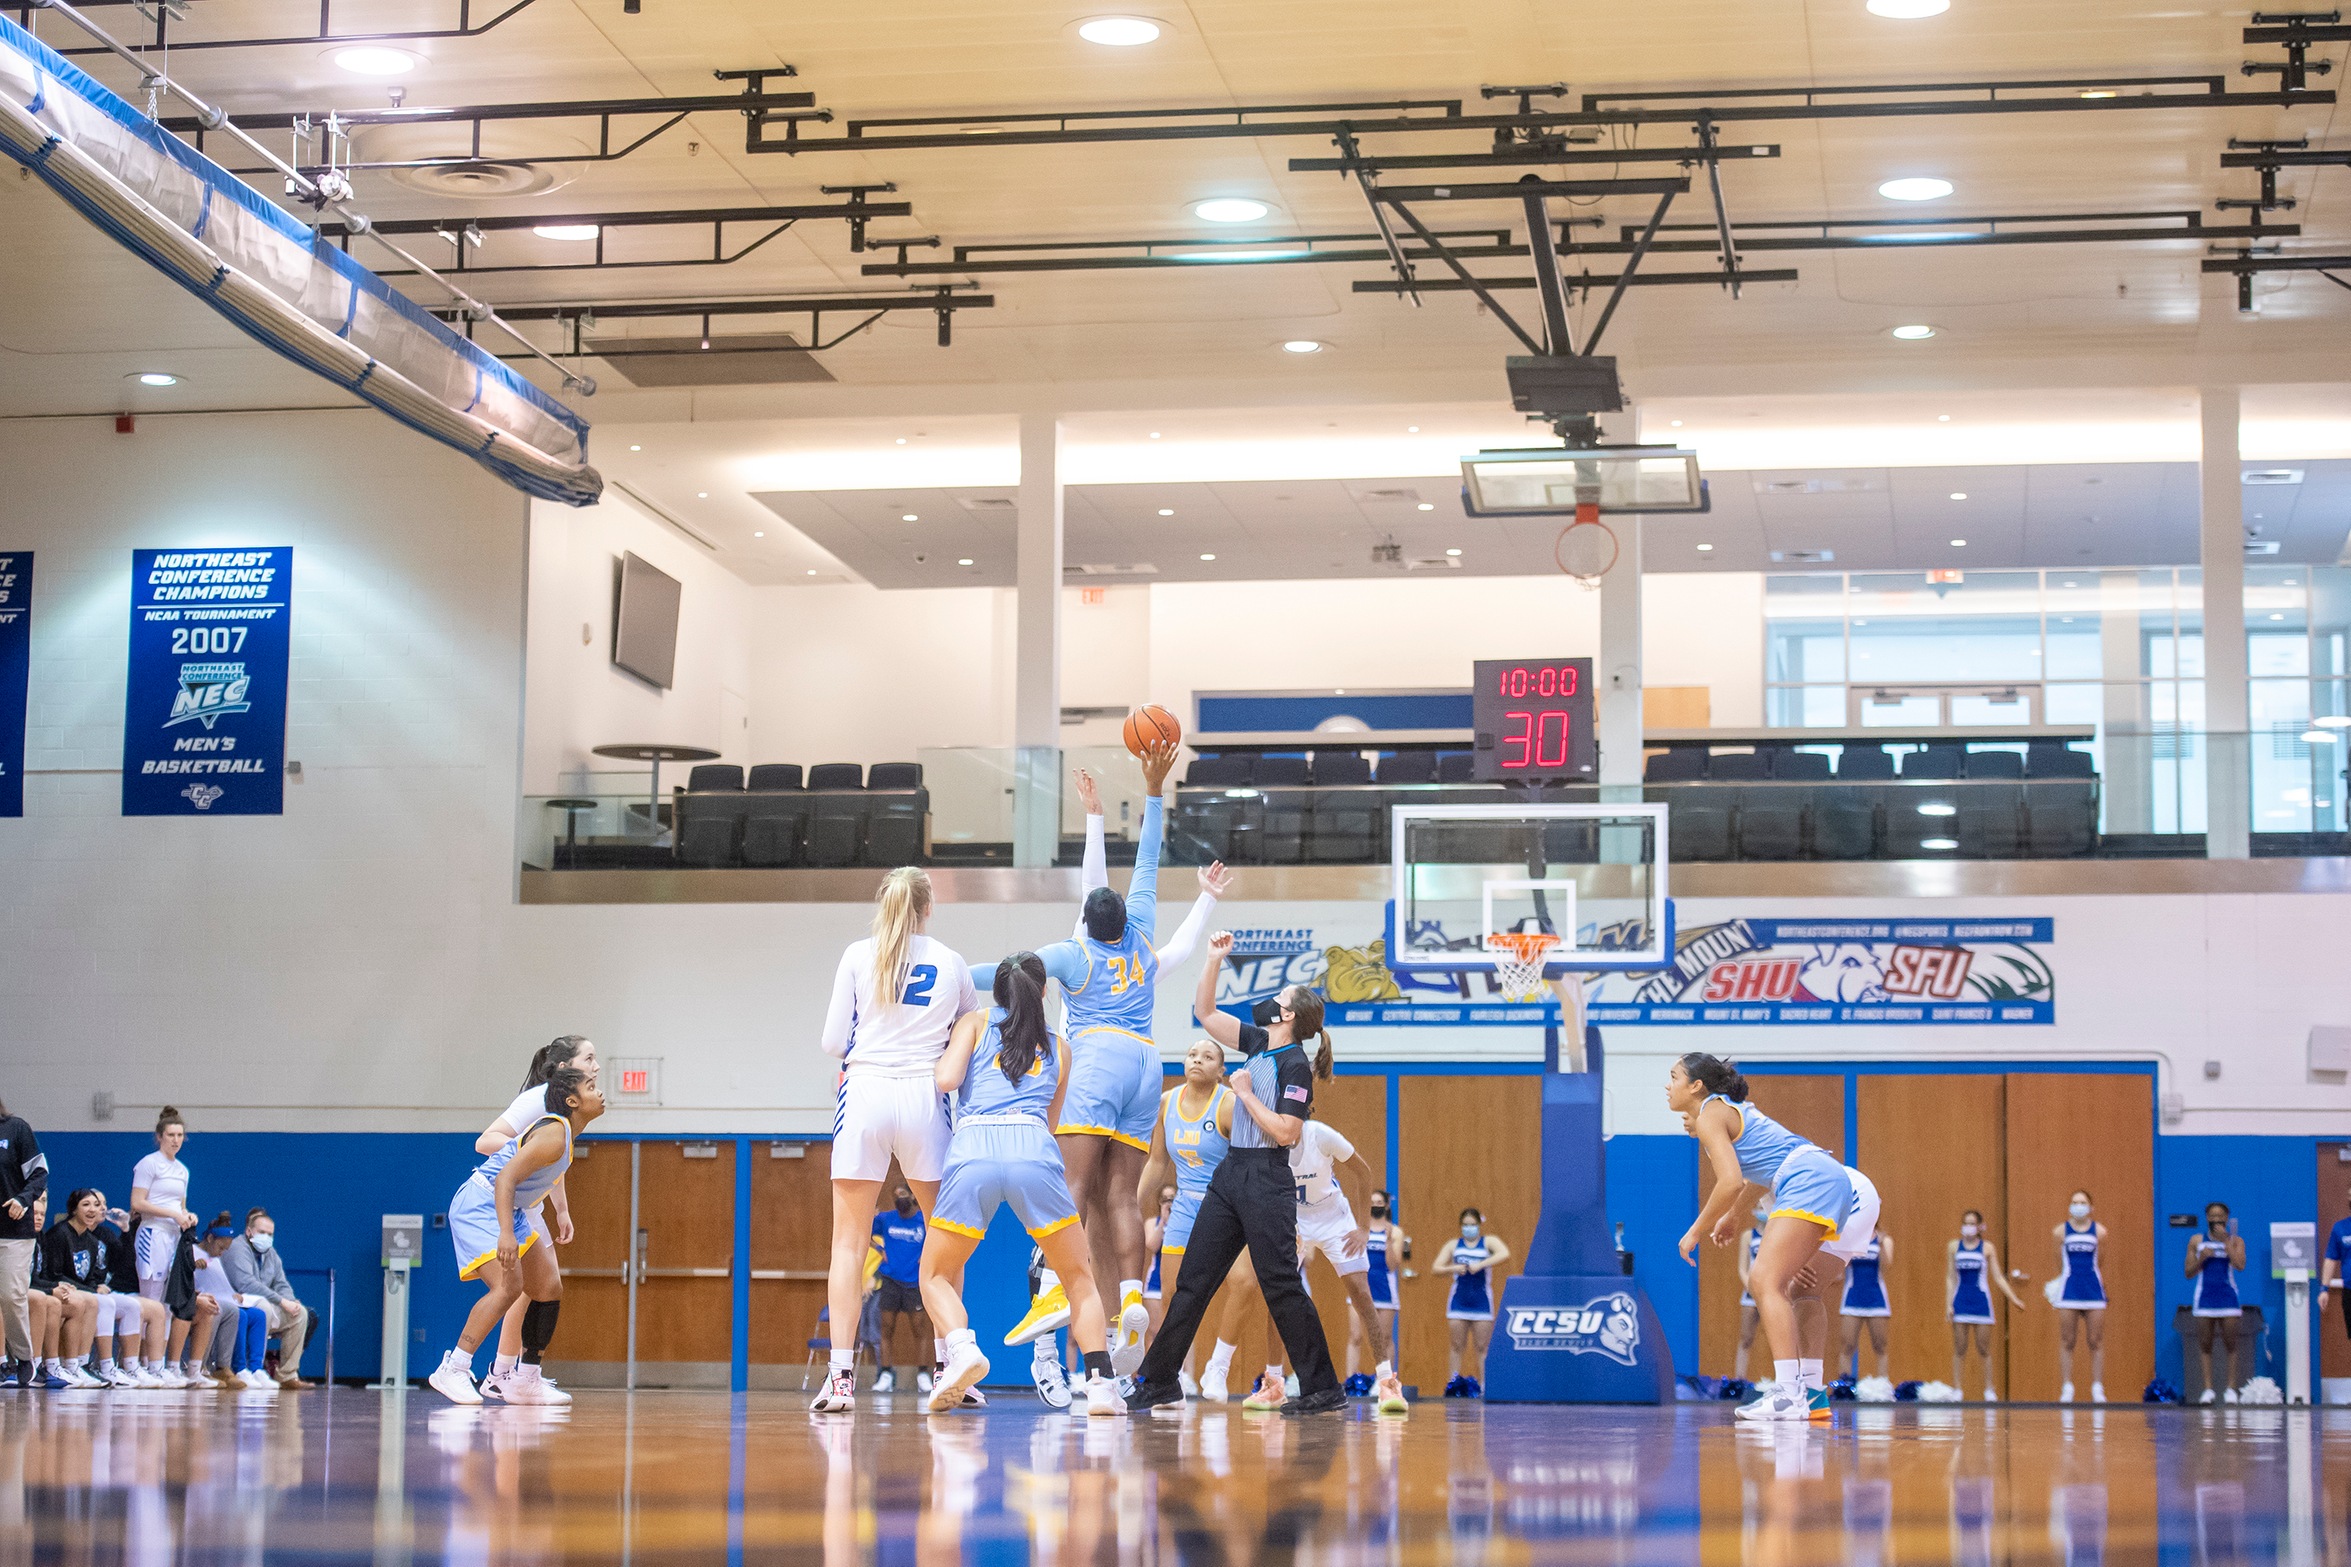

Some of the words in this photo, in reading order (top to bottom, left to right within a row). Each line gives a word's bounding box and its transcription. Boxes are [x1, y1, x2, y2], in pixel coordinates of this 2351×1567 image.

[153, 552, 272, 568] NORTHEAST
[148, 568, 275, 584] CONFERENCE
[153, 585, 268, 600] CHAMPIONS
[144, 611, 180, 621] NCAA
[184, 609, 276, 620] TOURNAMENT
[171, 627, 248, 654] 2007
[1500, 667, 1578, 698] 10:00
[172, 679, 248, 713] NEC
[174, 736, 236, 751] MEN'S
[1501, 711, 1569, 768] 30
[141, 759, 265, 774] BASKETBALL
[1226, 929, 1313, 940] ORTHEAST
[1230, 941, 1313, 951] ONFERENCE
[1107, 950, 1146, 996] 34
[1214, 950, 1321, 1002] NEC
[1703, 959, 1803, 1002] SHU
[1884, 947, 1972, 998] SFU
[623, 1071, 647, 1091] EXIT
[1511, 1311, 1604, 1334] CCSU
